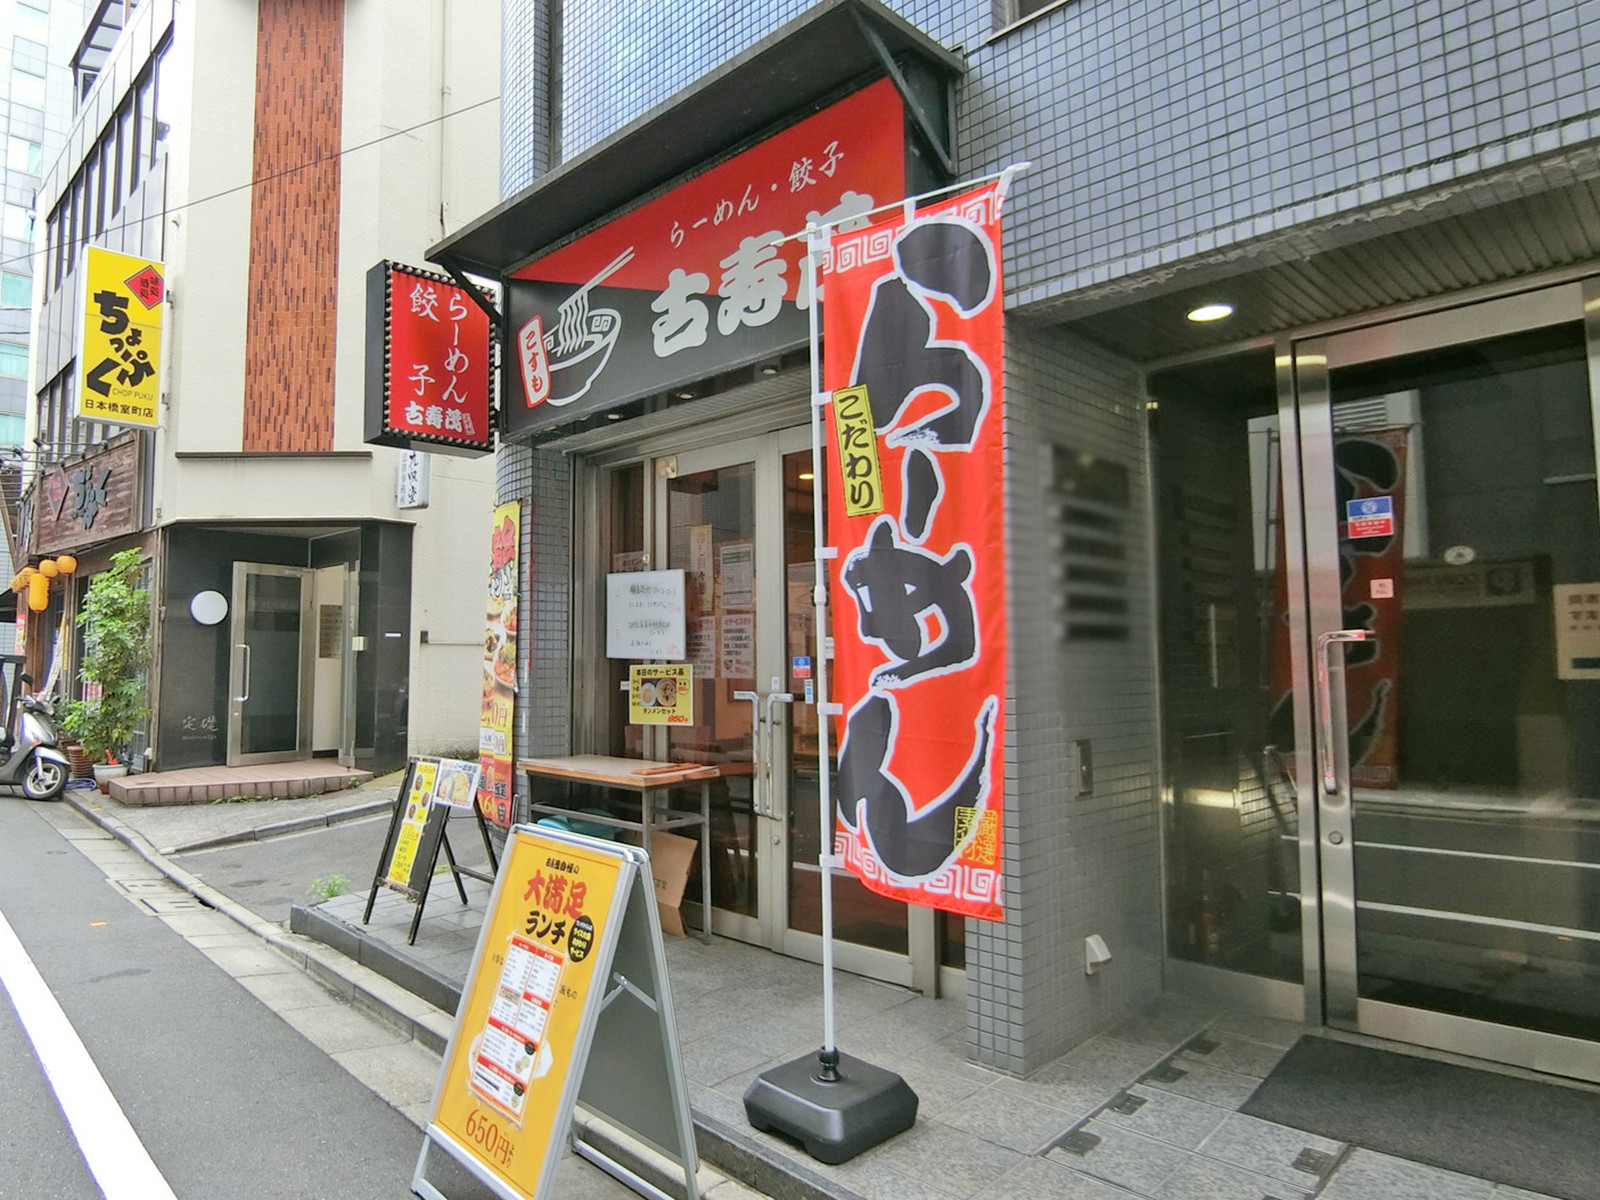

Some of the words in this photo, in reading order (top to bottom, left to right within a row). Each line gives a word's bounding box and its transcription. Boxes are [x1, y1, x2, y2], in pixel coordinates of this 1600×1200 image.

[669, 140, 845, 250] らーめん・餃子
[408, 283, 441, 397] 餃子
[441, 292, 470, 404] らーめん
[523, 330, 544, 393] こすも
[85, 398, 154, 418] 日本橋室町店
[838, 394, 876, 510] こだわり
[836, 217, 998, 882] らーめん
[636, 667, 685, 677] 本日のサービス品
[182, 715, 219, 731] 定礎
[523, 868, 588, 919] 大満足
[525, 910, 567, 945] ランチ
